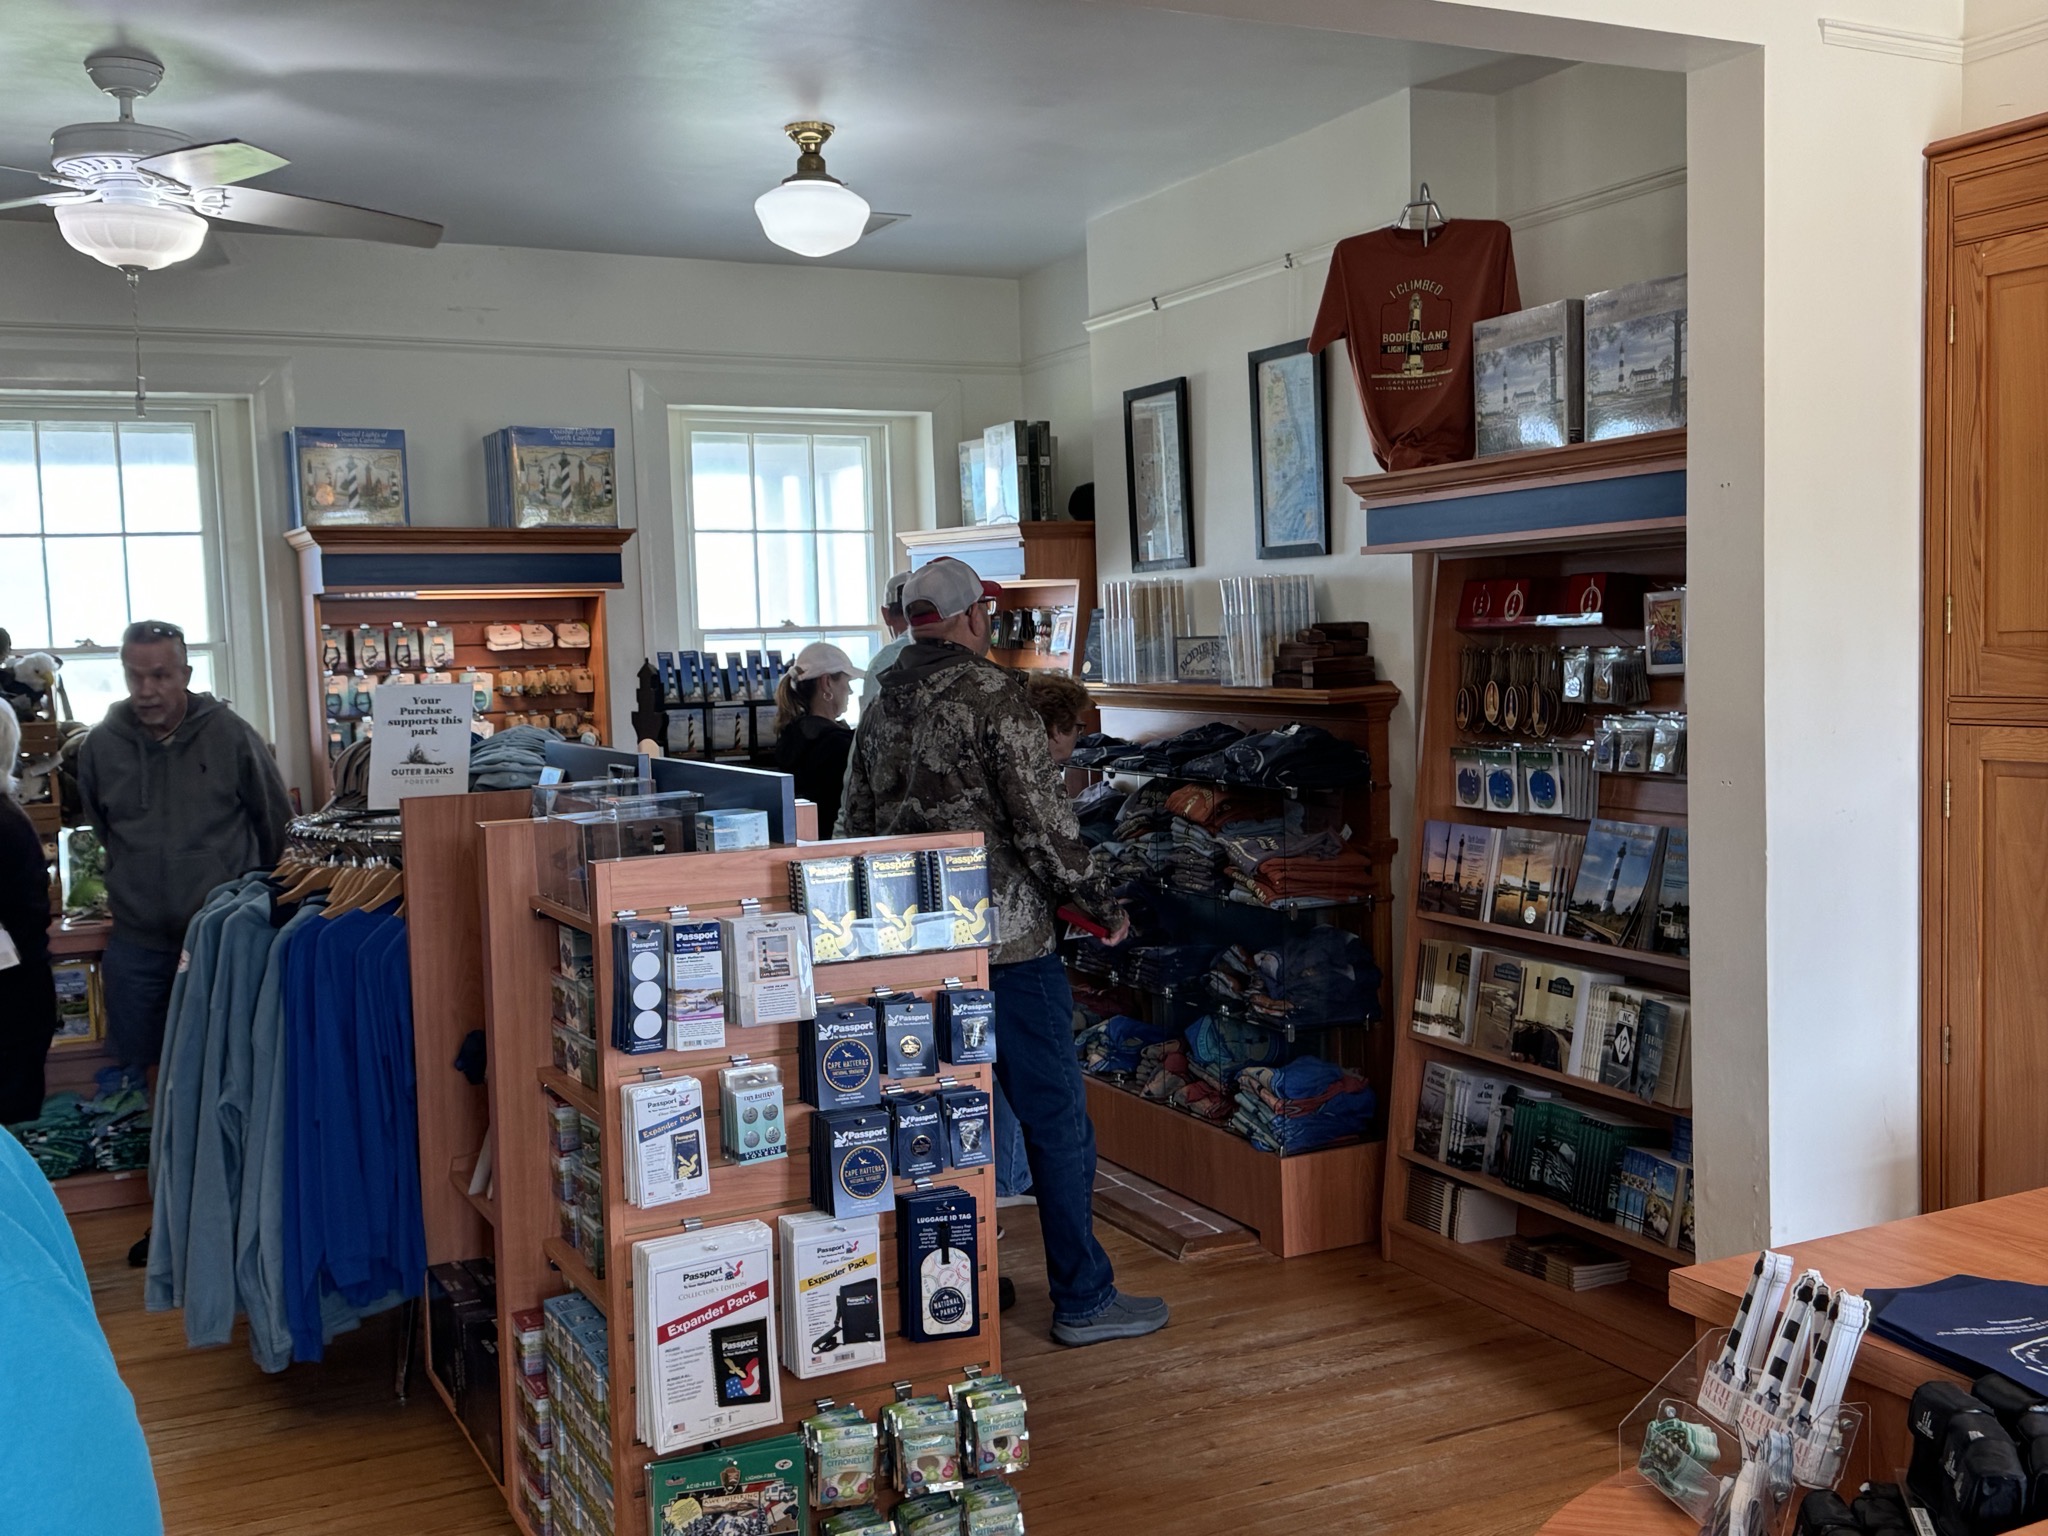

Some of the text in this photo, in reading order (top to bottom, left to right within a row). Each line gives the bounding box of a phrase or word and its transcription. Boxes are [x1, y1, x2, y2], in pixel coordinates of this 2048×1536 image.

[1396, 279, 1444, 297] CLIMBED
[1382, 332, 1410, 343] BODIE
[1387, 342, 1444, 353] LIGHT HOUSE
[412, 697, 442, 705] Your
[400, 706, 453, 716] Purchase
[387, 716, 463, 728] supports this
[411, 727, 438, 738] park
[391, 767, 454, 776] OUTER BANKS
[945, 852, 987, 865] Passport
[872, 858, 916, 871] Passport
[808, 864, 854, 877] Passport
[675, 930, 718, 941] Passport
[631, 941, 659, 949] Passport
[963, 1002, 992, 1011] Passport
[899, 1013, 930, 1021] Passport
[1622, 1012, 1632, 1023] NC
[833, 1021, 874, 1033] Passport
[1619, 1035, 1628, 1055] 12
[827, 1058, 869, 1070] CAPE HATTERAS
[647, 1098, 677, 1109] Passport
[962, 1103, 988, 1113] Passport
[910, 1112, 938, 1122] Passport
[642, 1111, 698, 1139] Expander Pack
[848, 1127, 887, 1140] Passport
[844, 1164, 885, 1178] CAPE HATTERAS
[917, 1215, 948, 1224] LUGGAGE
[817, 1243, 845, 1254] Passport
[683, 1266, 723, 1282] Passport
[807, 1258, 869, 1288] Expander Pack
[678, 1280, 747, 1300] COLLECTOR'S EDITION
[933, 1297, 961, 1310] NATIONAL
[667, 1290, 758, 1337] Expander Pack
[939, 1306, 958, 1317] PARKS
[722, 1337, 758, 1351] Passport
[983, 1420, 1023, 1433] CITRONELLA
[826, 1456, 870, 1468] CITRONELLA
[685, 1480, 717, 1490] ACID-FREE
[721, 1492, 759, 1502] INSPIRING
